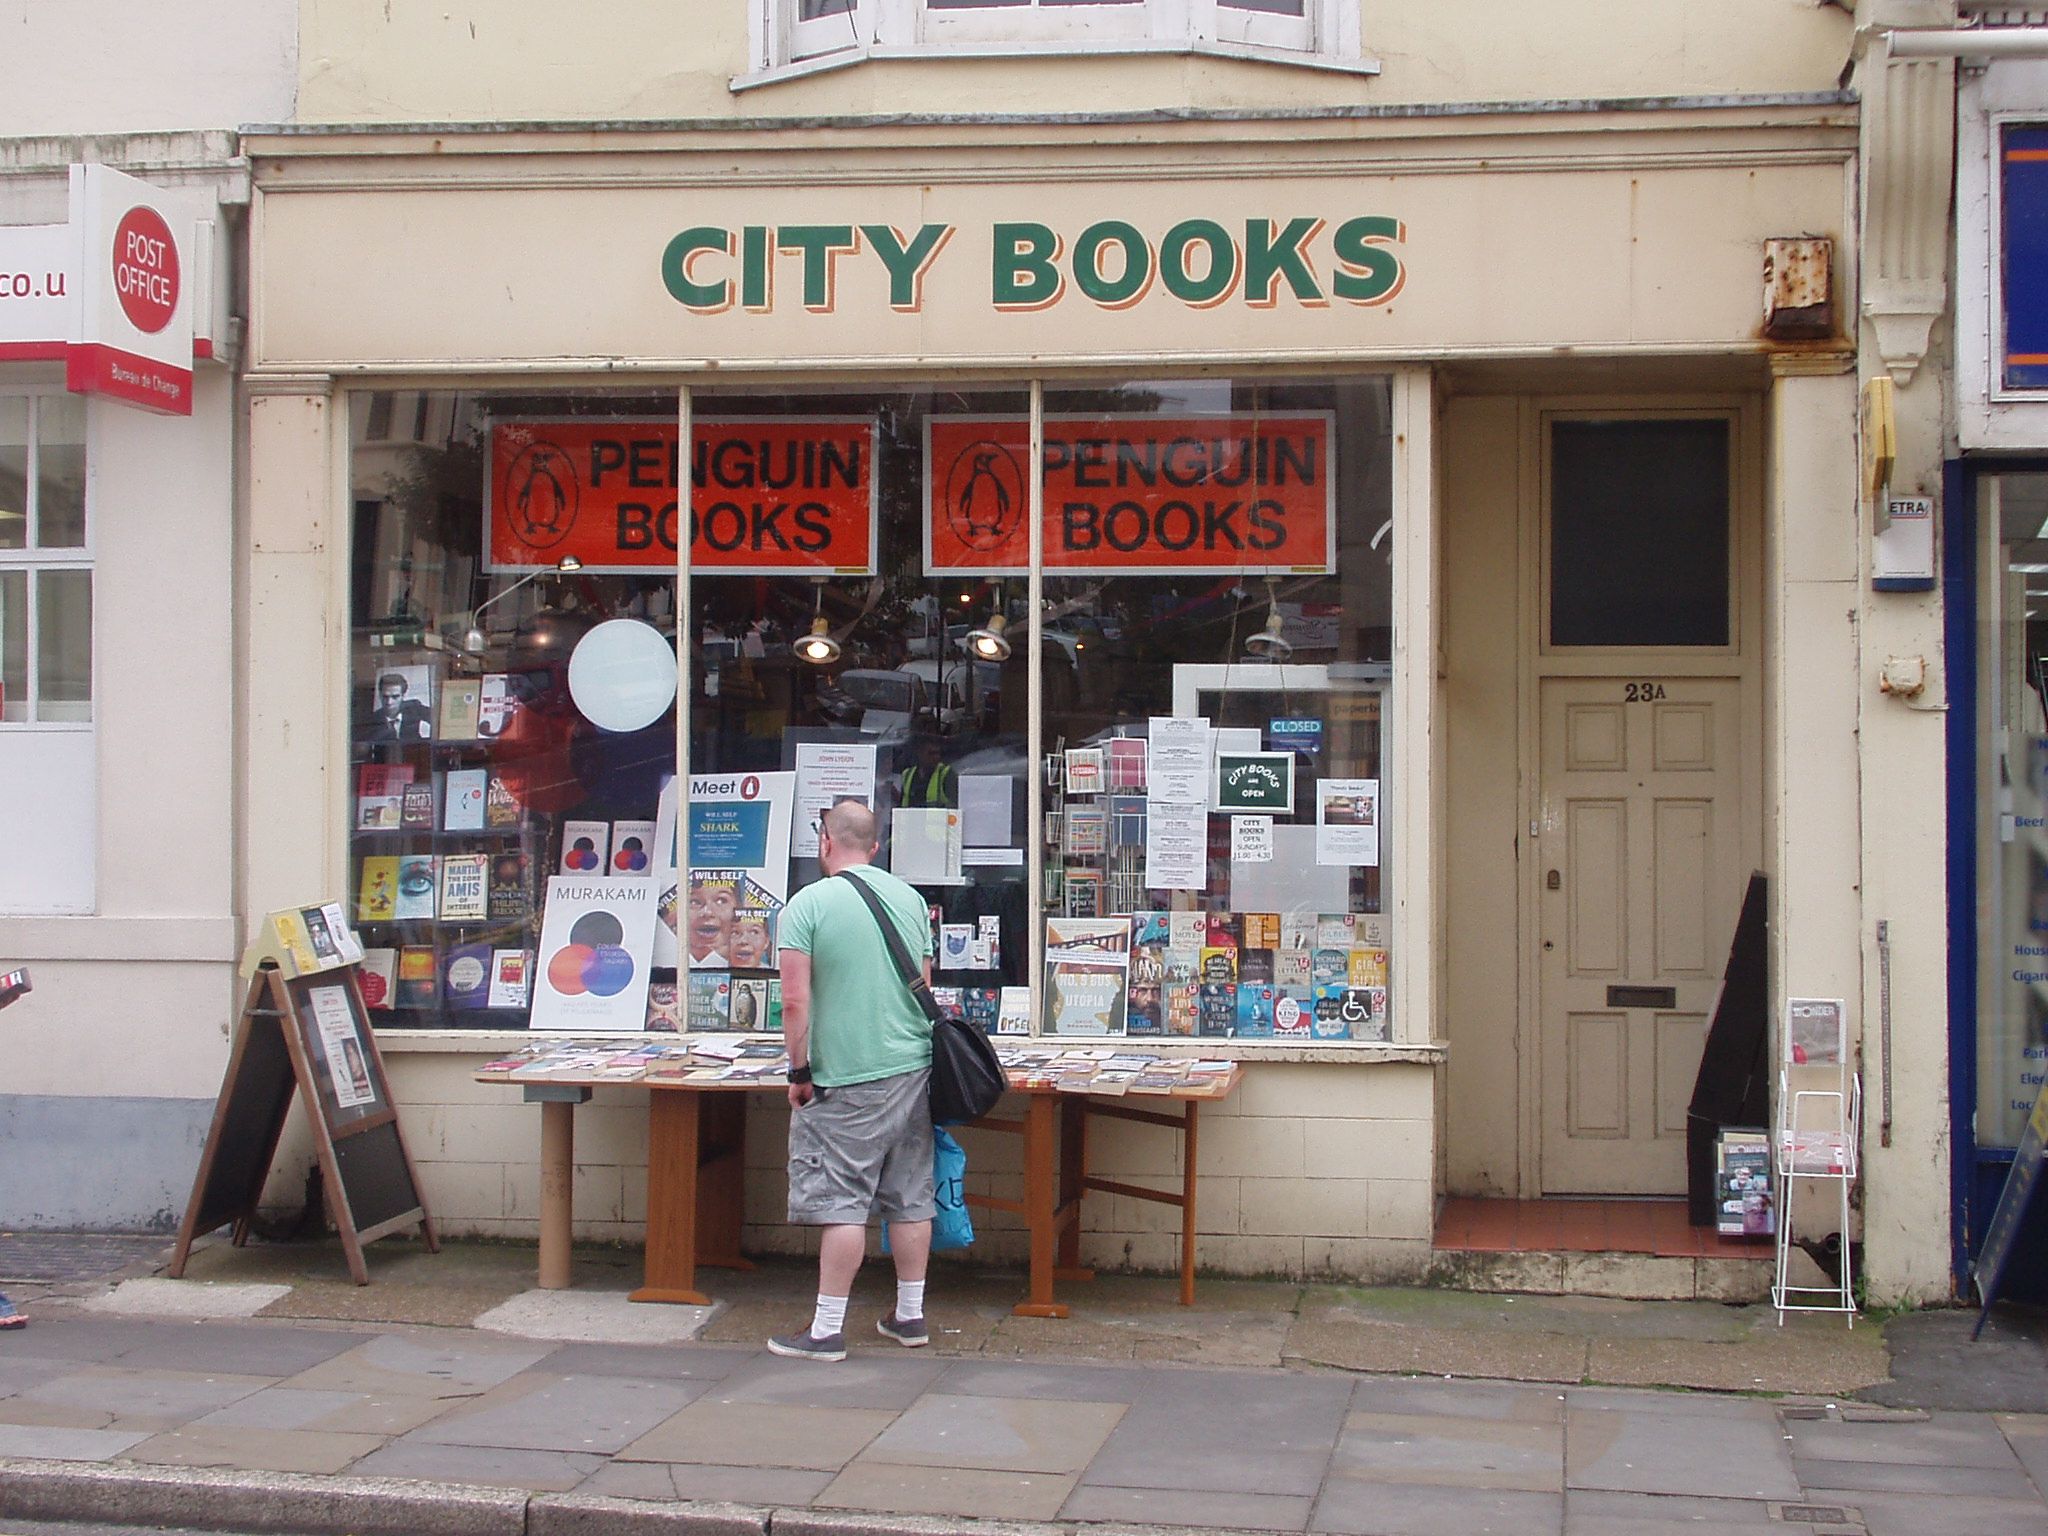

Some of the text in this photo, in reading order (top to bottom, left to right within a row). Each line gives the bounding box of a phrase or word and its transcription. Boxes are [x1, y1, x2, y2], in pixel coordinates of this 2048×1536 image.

[126, 231, 165, 269] POST
[661, 215, 1406, 315] CITY BOOKS
[118, 266, 171, 307] OFFICE
[111, 363, 140, 384] Bureau
[153, 376, 180, 398] Change
[590, 440, 860, 489] PENGUIN
[1042, 436, 1316, 488] PENGUIN
[617, 501, 833, 552] BOOKS
[1063, 500, 1287, 551] BOOKS
[1624, 682, 1666, 702] 23A
[1272, 720, 1320, 732] CLOSED
[1228, 764, 1280, 788] CITY BOOKS
[692, 781, 736, 795] Meet
[1241, 789, 1265, 797] OPEN
[700, 823, 739, 833] SHARK
[2015, 815, 2043, 827] Beer
[448, 865, 481, 875] MARTIN
[694, 871, 744, 880] WILL SELF
[447, 882, 480, 897] AMIS
[702, 880, 735, 888] SHARK
[556, 887, 647, 901] MURAKAMI
[2015, 945, 2048, 956] Hous
[1065, 994, 1104, 1007] UTOPIA
